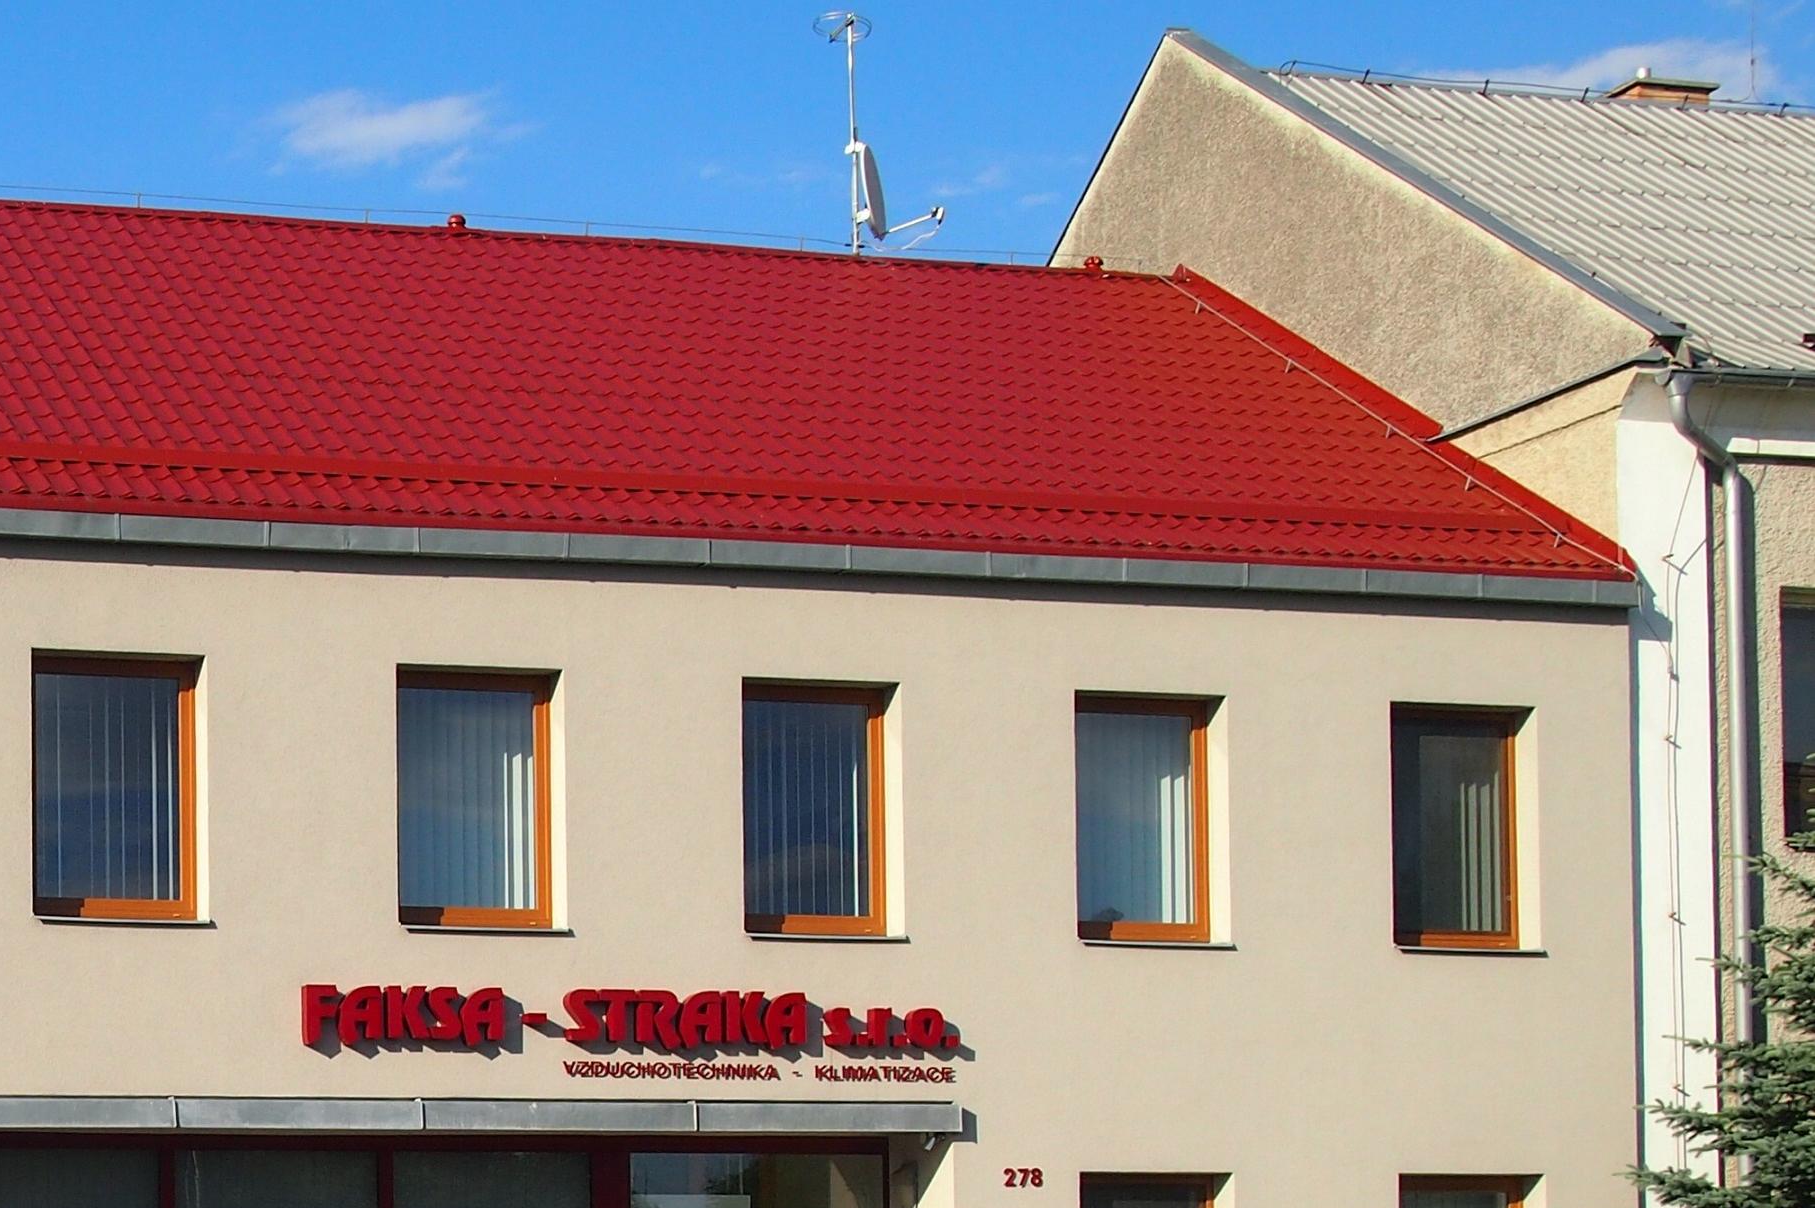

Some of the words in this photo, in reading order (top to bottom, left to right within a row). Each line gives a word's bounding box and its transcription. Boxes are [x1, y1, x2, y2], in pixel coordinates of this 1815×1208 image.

[301, 984, 506, 1047] FAKSA
[563, 988, 807, 1049] STRAKA
[823, 1007, 960, 1048] s.r.o.
[563, 1061, 780, 1080] VZDUCHOTECHNIKA
[814, 1065, 956, 1083] KLIMATIZACE
[1003, 1167, 1043, 1188] 278
